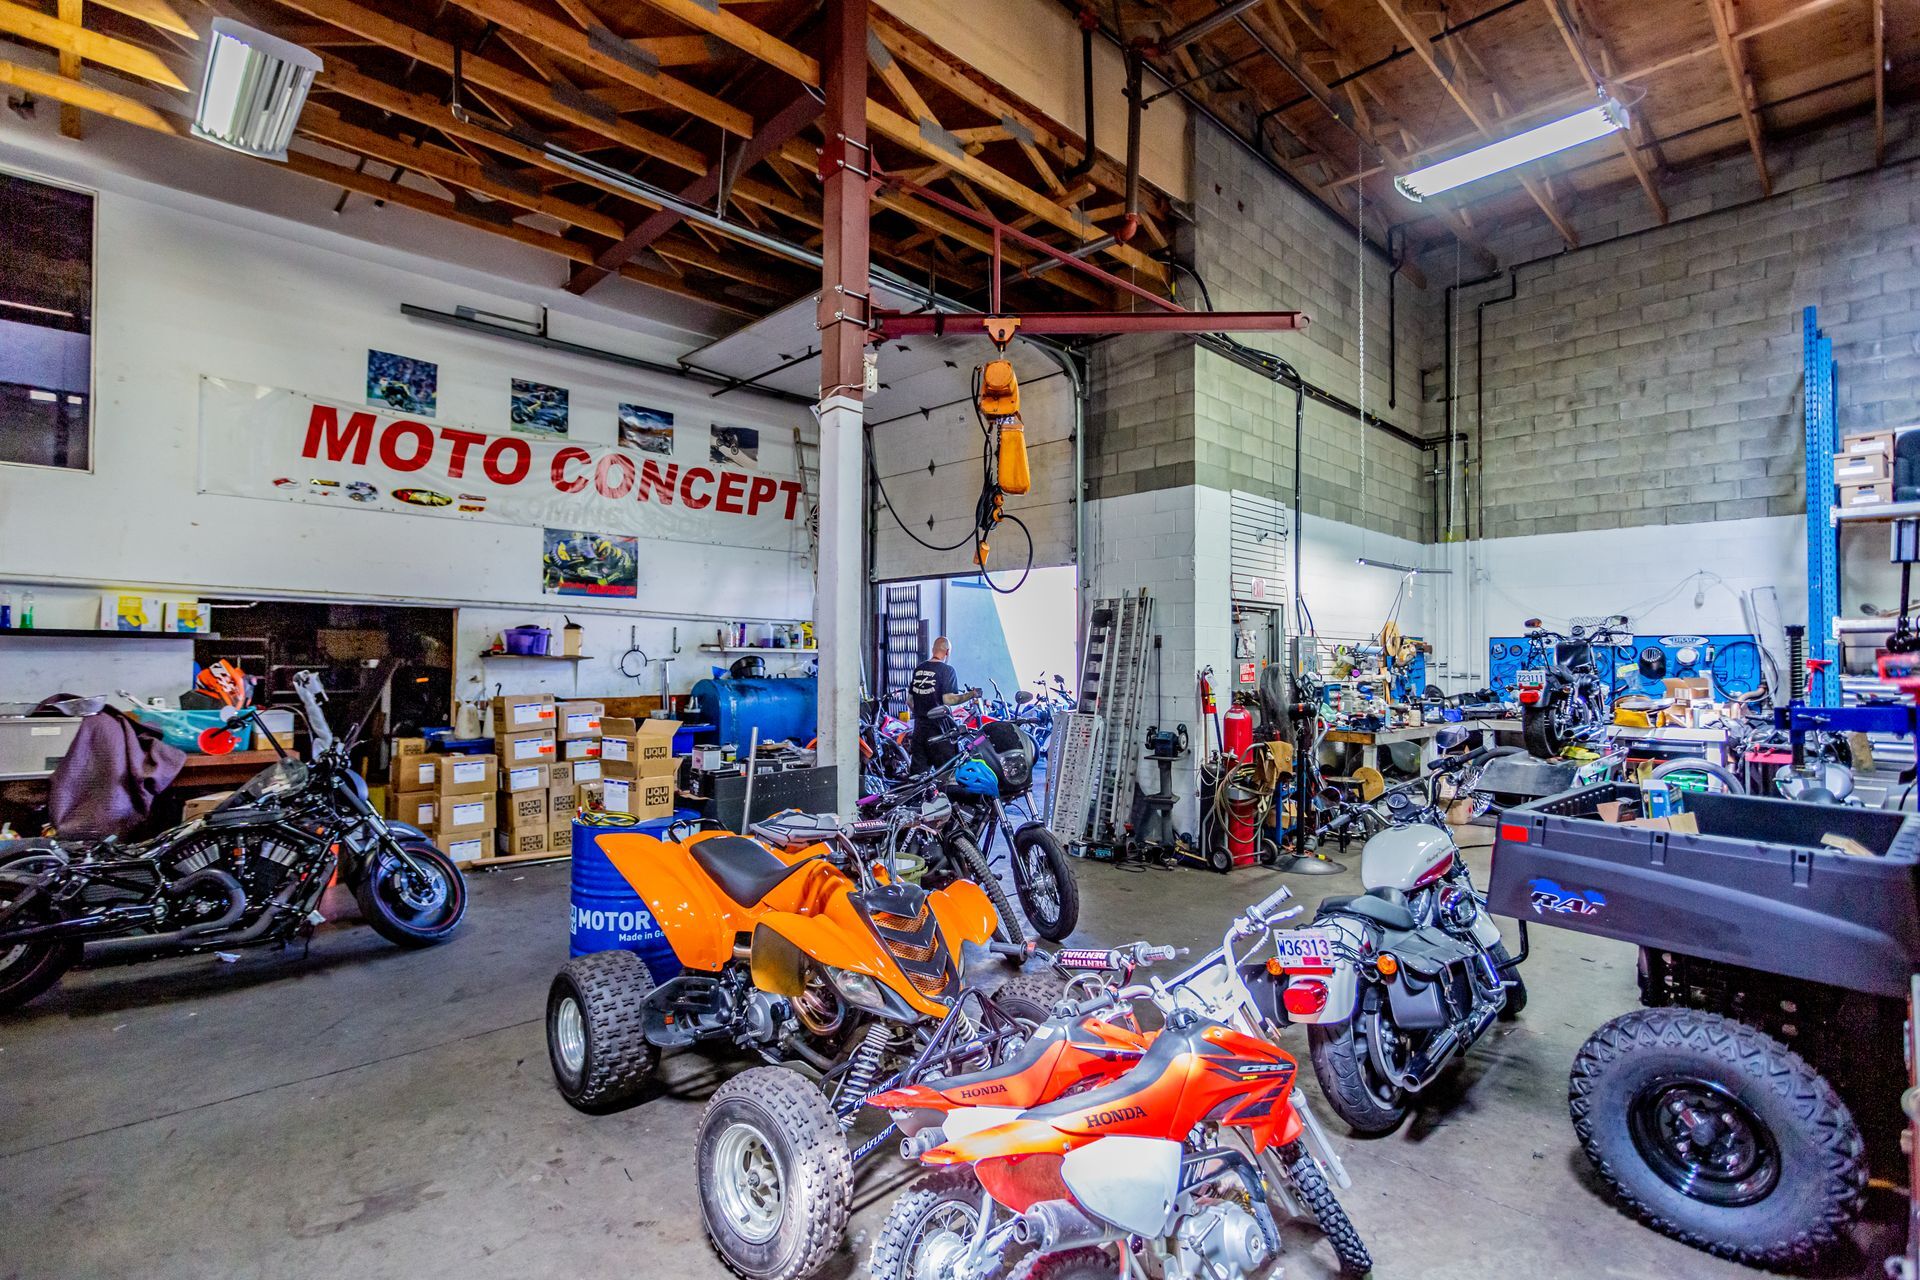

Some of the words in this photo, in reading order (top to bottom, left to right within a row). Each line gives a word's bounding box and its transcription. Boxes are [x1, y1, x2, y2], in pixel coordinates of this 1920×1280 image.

[302, 404, 531, 485] MOTO
[551, 447, 803, 521] CONCEPT
[645, 747, 667, 757] LIQUI
[646, 786, 669, 796] LIQUI
[519, 800, 541, 808] LIQUI
[554, 795, 575, 804] LIQUI
[646, 795, 669, 806] MOLY
[520, 807, 541, 816] MOLY
[555, 802, 575, 811] MOLY
[854, 821, 886, 829] RENTHAL
[521, 835, 543, 844] LIQUI
[521, 842, 543, 851] MOLY
[578, 908, 651, 932] MOTOR
[619, 933, 642, 941] Made
[645, 931, 652, 939] in
[1277, 939, 1329, 956] W36313
[1063, 951, 1107, 959] RENTHAL
[1239, 1063, 1291, 1072] CRF
[961, 1084, 1008, 1099] HONDA
[1084, 1106, 1148, 1128] HONDA
[853, 1124, 894, 1160] FULLFLIGHT
